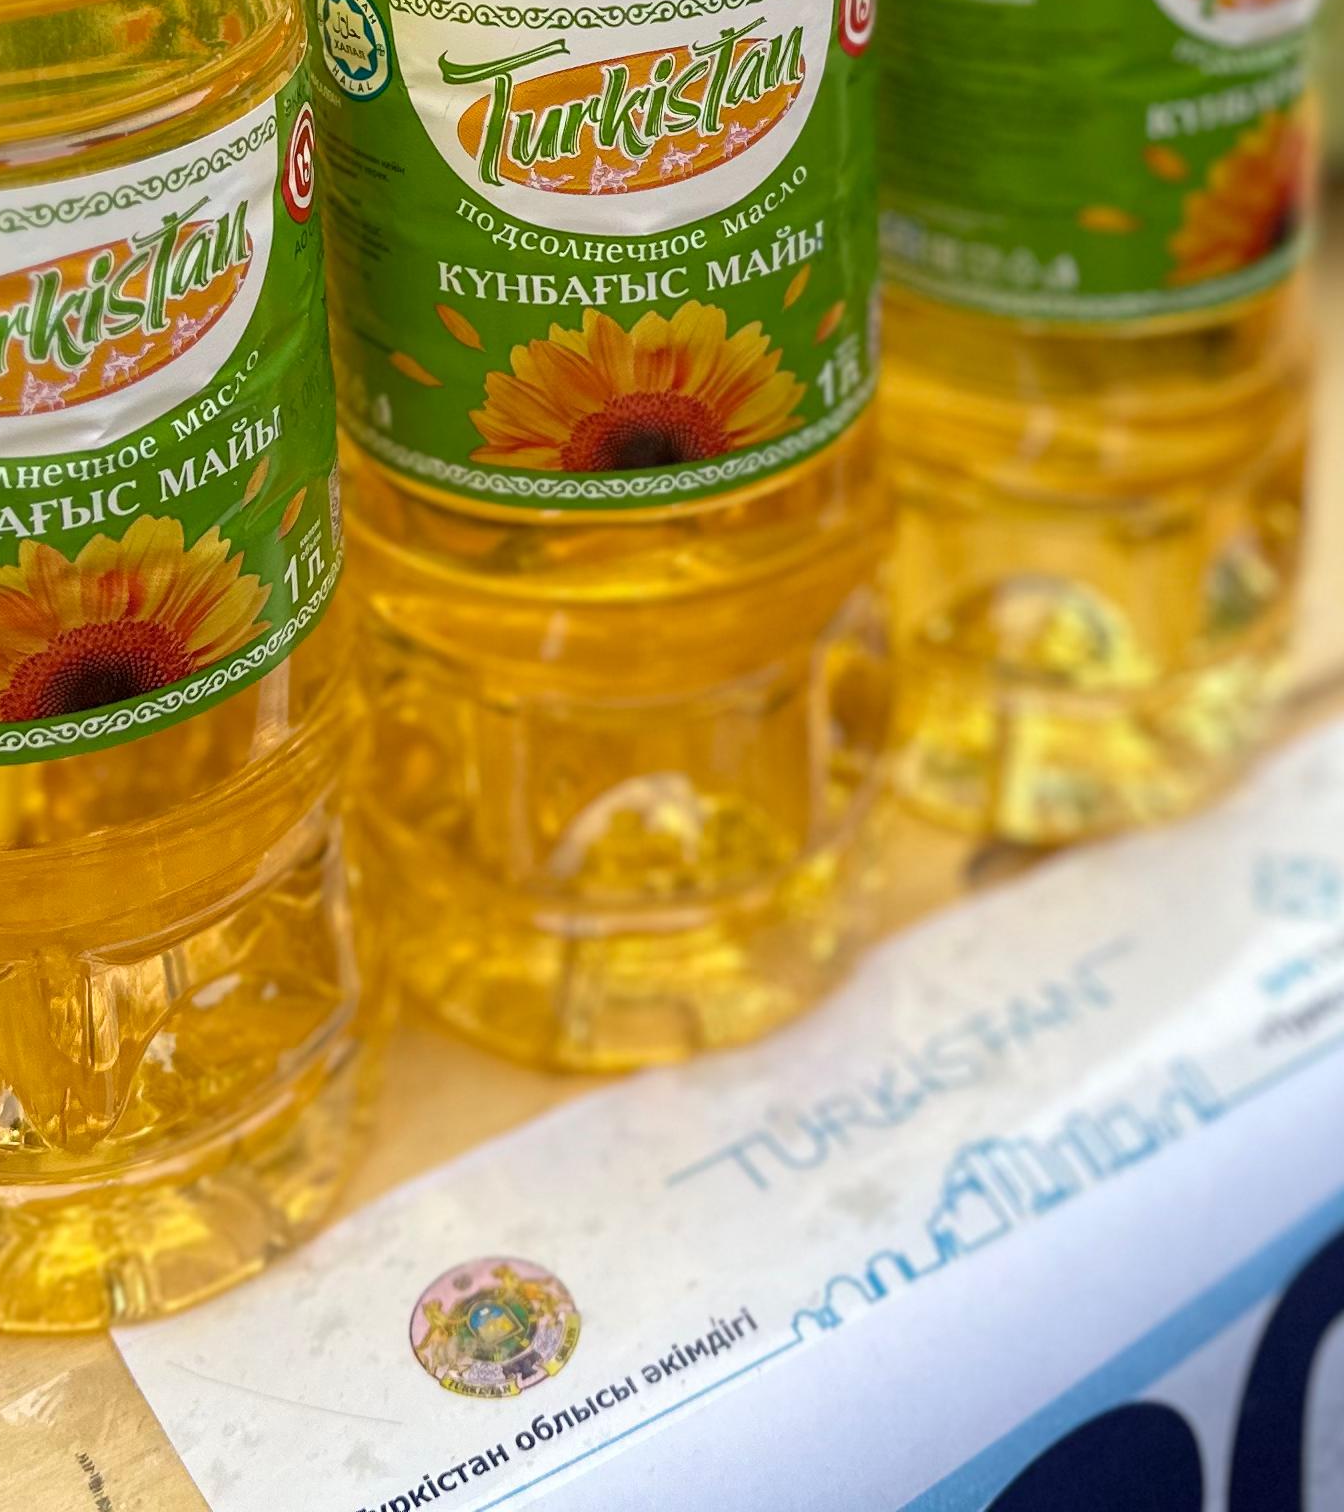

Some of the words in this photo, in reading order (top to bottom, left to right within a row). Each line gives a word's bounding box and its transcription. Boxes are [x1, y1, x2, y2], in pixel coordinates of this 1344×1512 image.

[331, 63, 375, 94] HALAL
[437, 16, 806, 188] Turkistan
[455, 197, 708, 264] подсолнечное
[719, 165, 809, 238] масло
[437, 261, 690, 307] КҮНБАҒЫС
[705, 220, 826, 292] МАЙЫ
[169, 349, 260, 443] масло
[157, 404, 282, 503] МАЙЫ
[284, 553, 299, 604] 1
[514, 1375, 639, 1453] облысы
